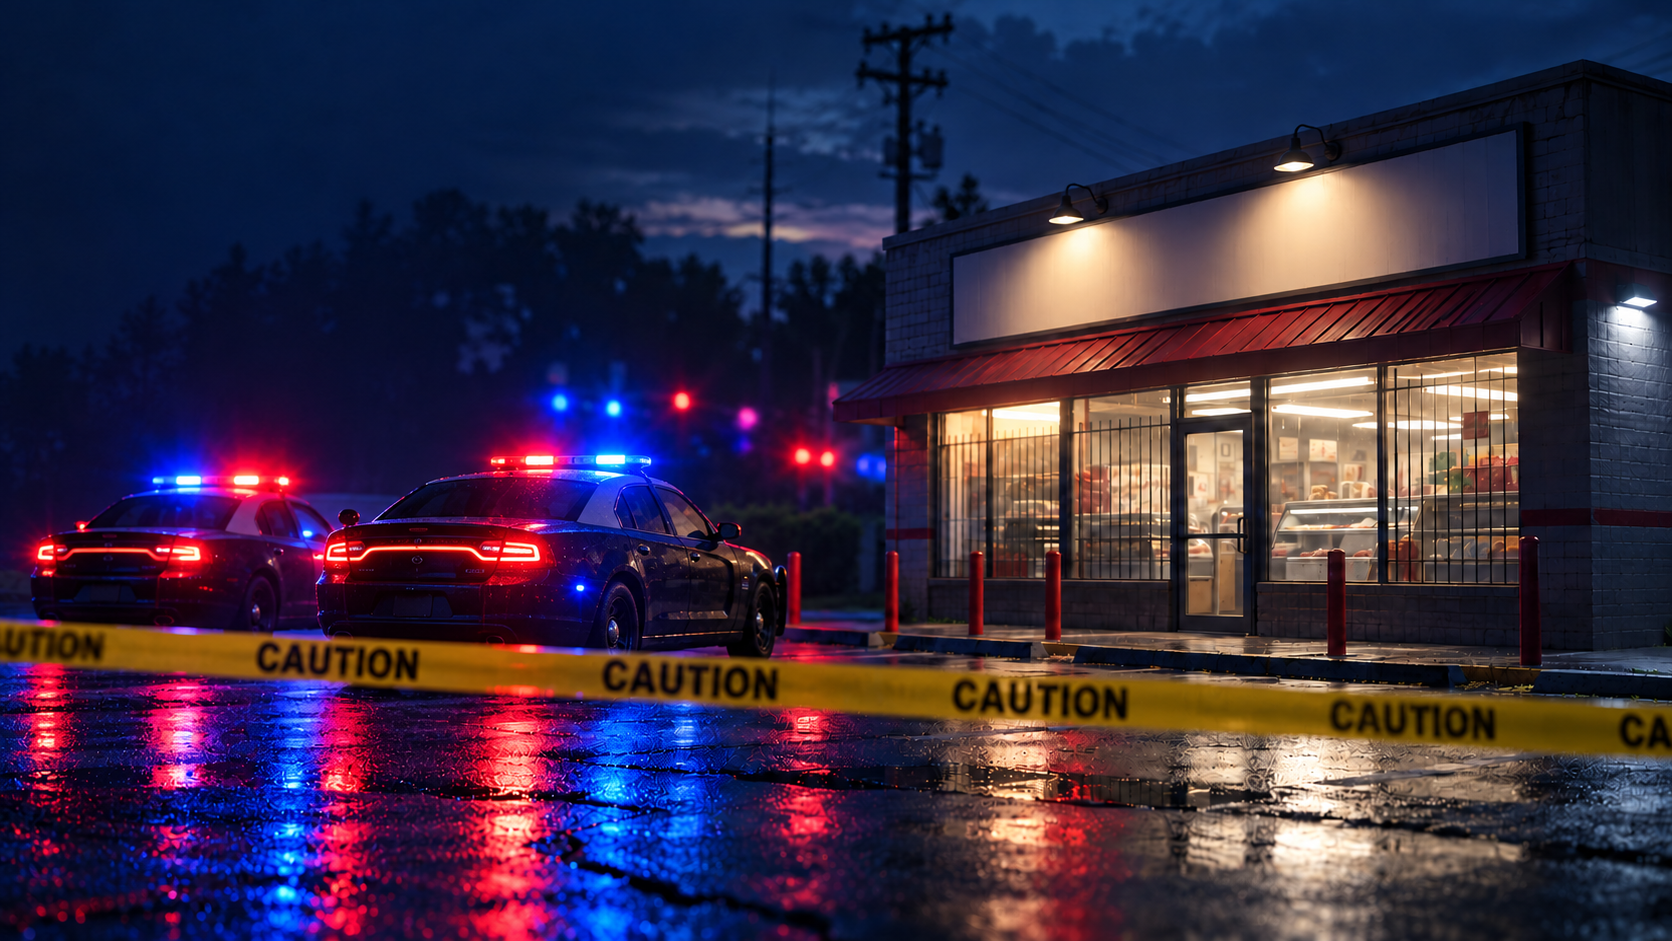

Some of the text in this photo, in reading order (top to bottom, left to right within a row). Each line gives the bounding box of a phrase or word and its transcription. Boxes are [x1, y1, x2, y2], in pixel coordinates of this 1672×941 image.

[0, 629, 1672, 749] UTION CAUTION CAUTION CAUTION CAUTION CA
